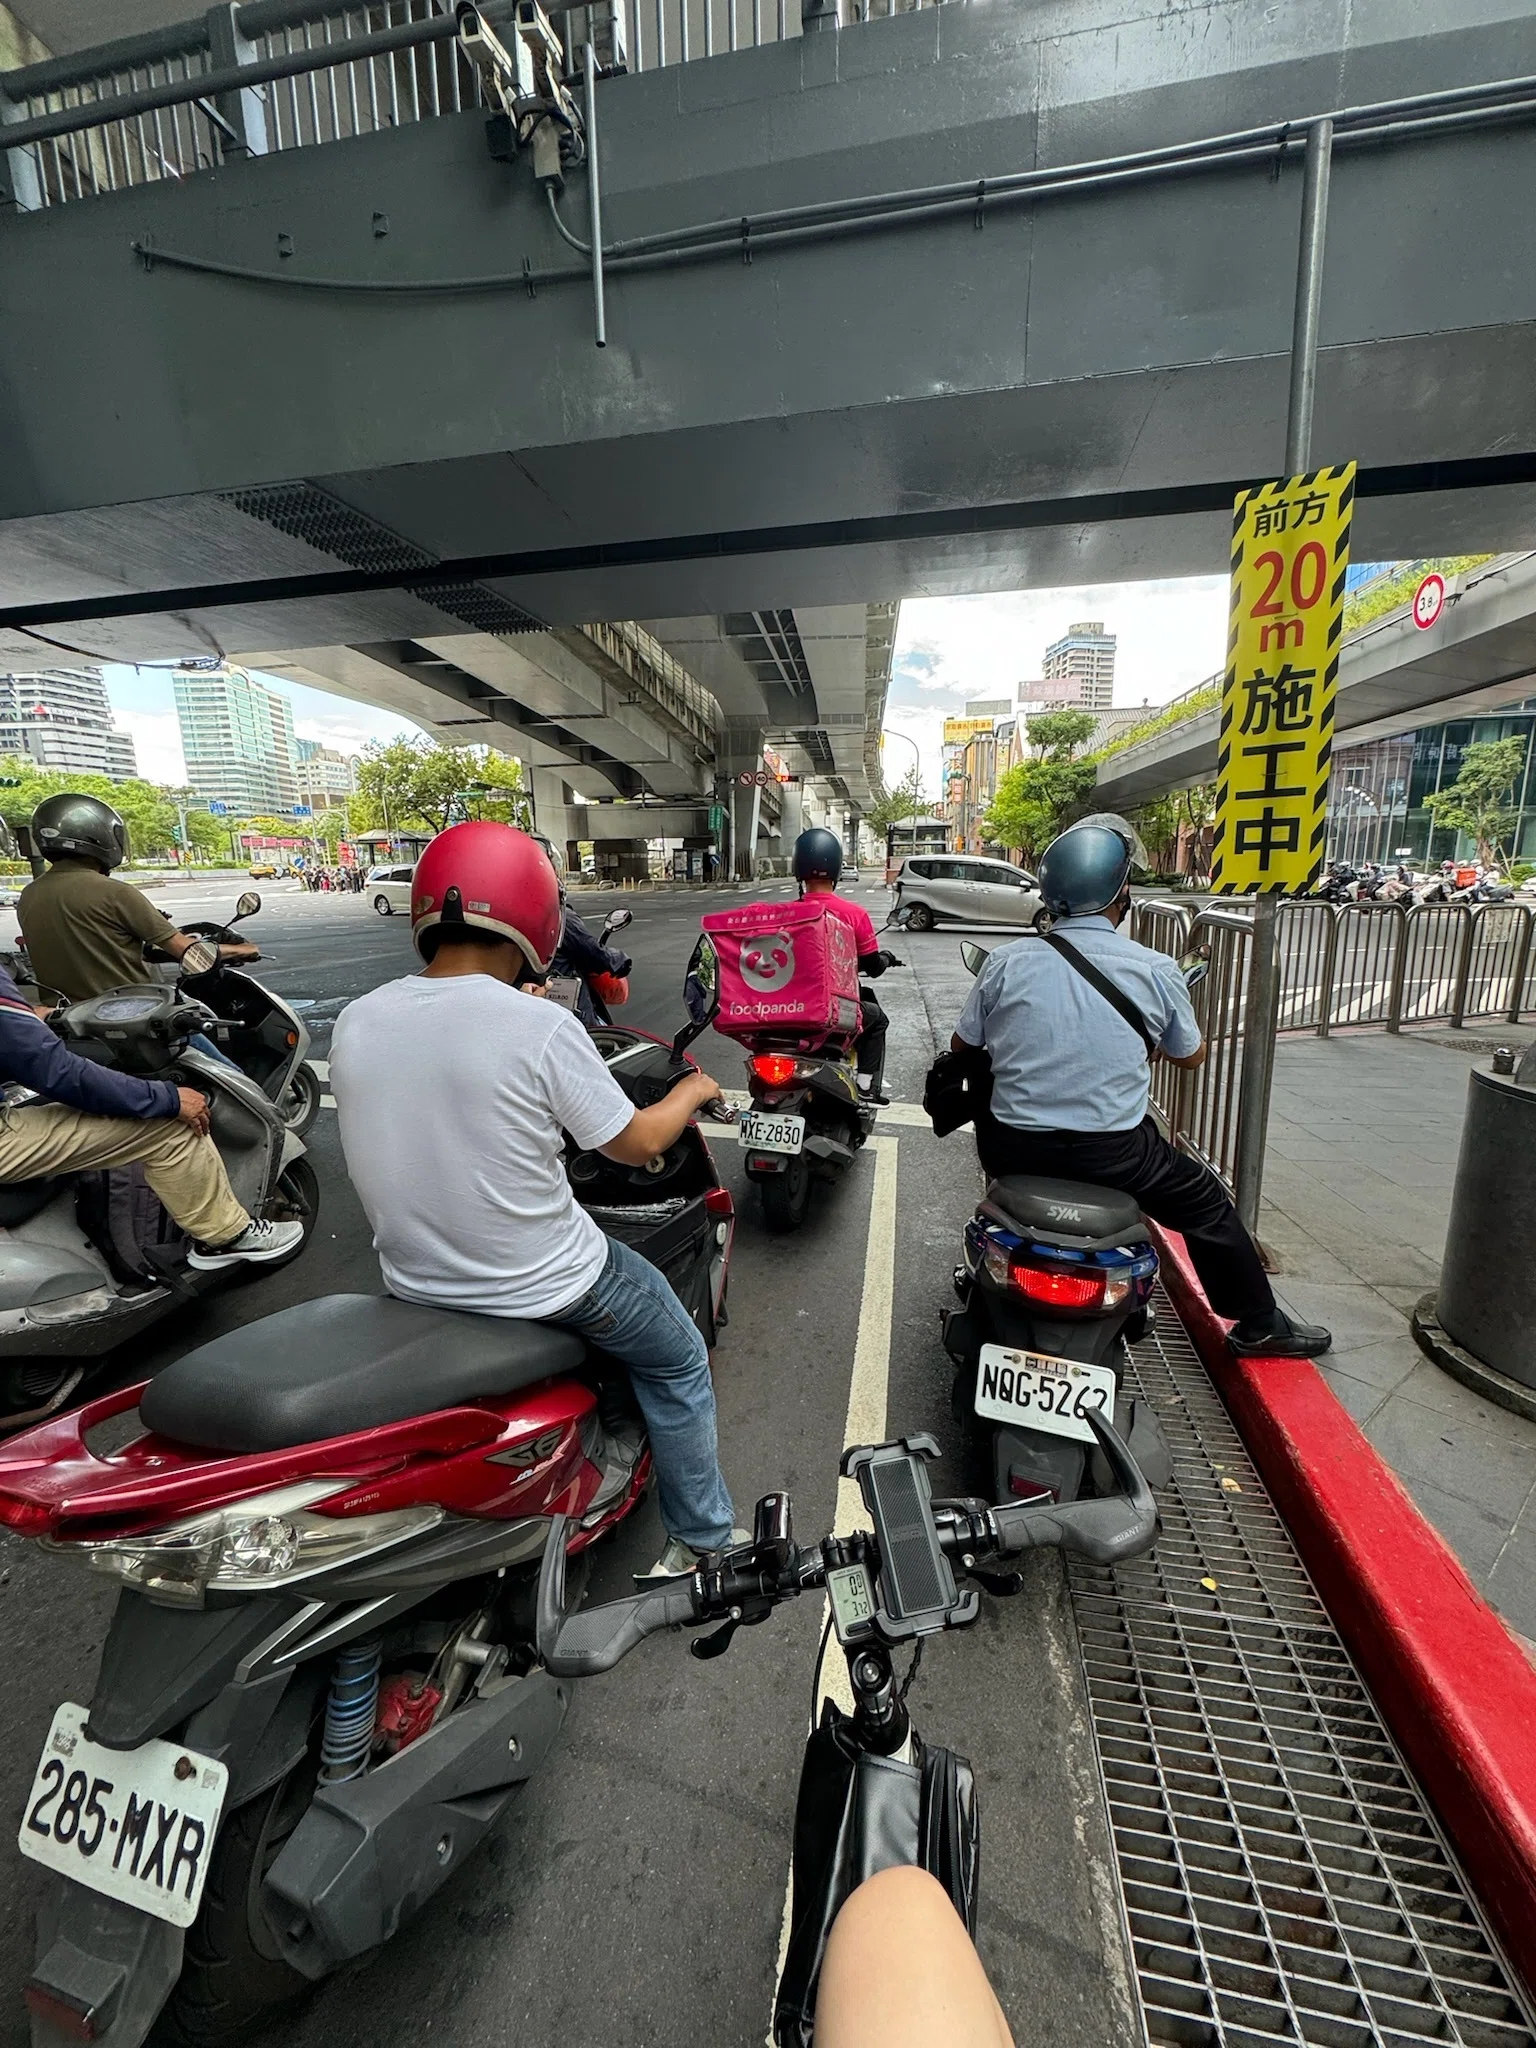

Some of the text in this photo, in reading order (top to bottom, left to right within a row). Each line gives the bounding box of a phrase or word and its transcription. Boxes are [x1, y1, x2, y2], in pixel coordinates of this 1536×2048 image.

[1253, 491, 1330, 538] 前方
[1250, 541, 1327, 618] 20
[1259, 618, 1304, 652] m
[1234, 664, 1316, 871] 施工中
[729, 999, 805, 1017] foodpanda
[1047, 1205, 1081, 1222] SYM
[1115, 1525, 1140, 1543] GIANT
[560, 1649, 589, 1658] GIANT
